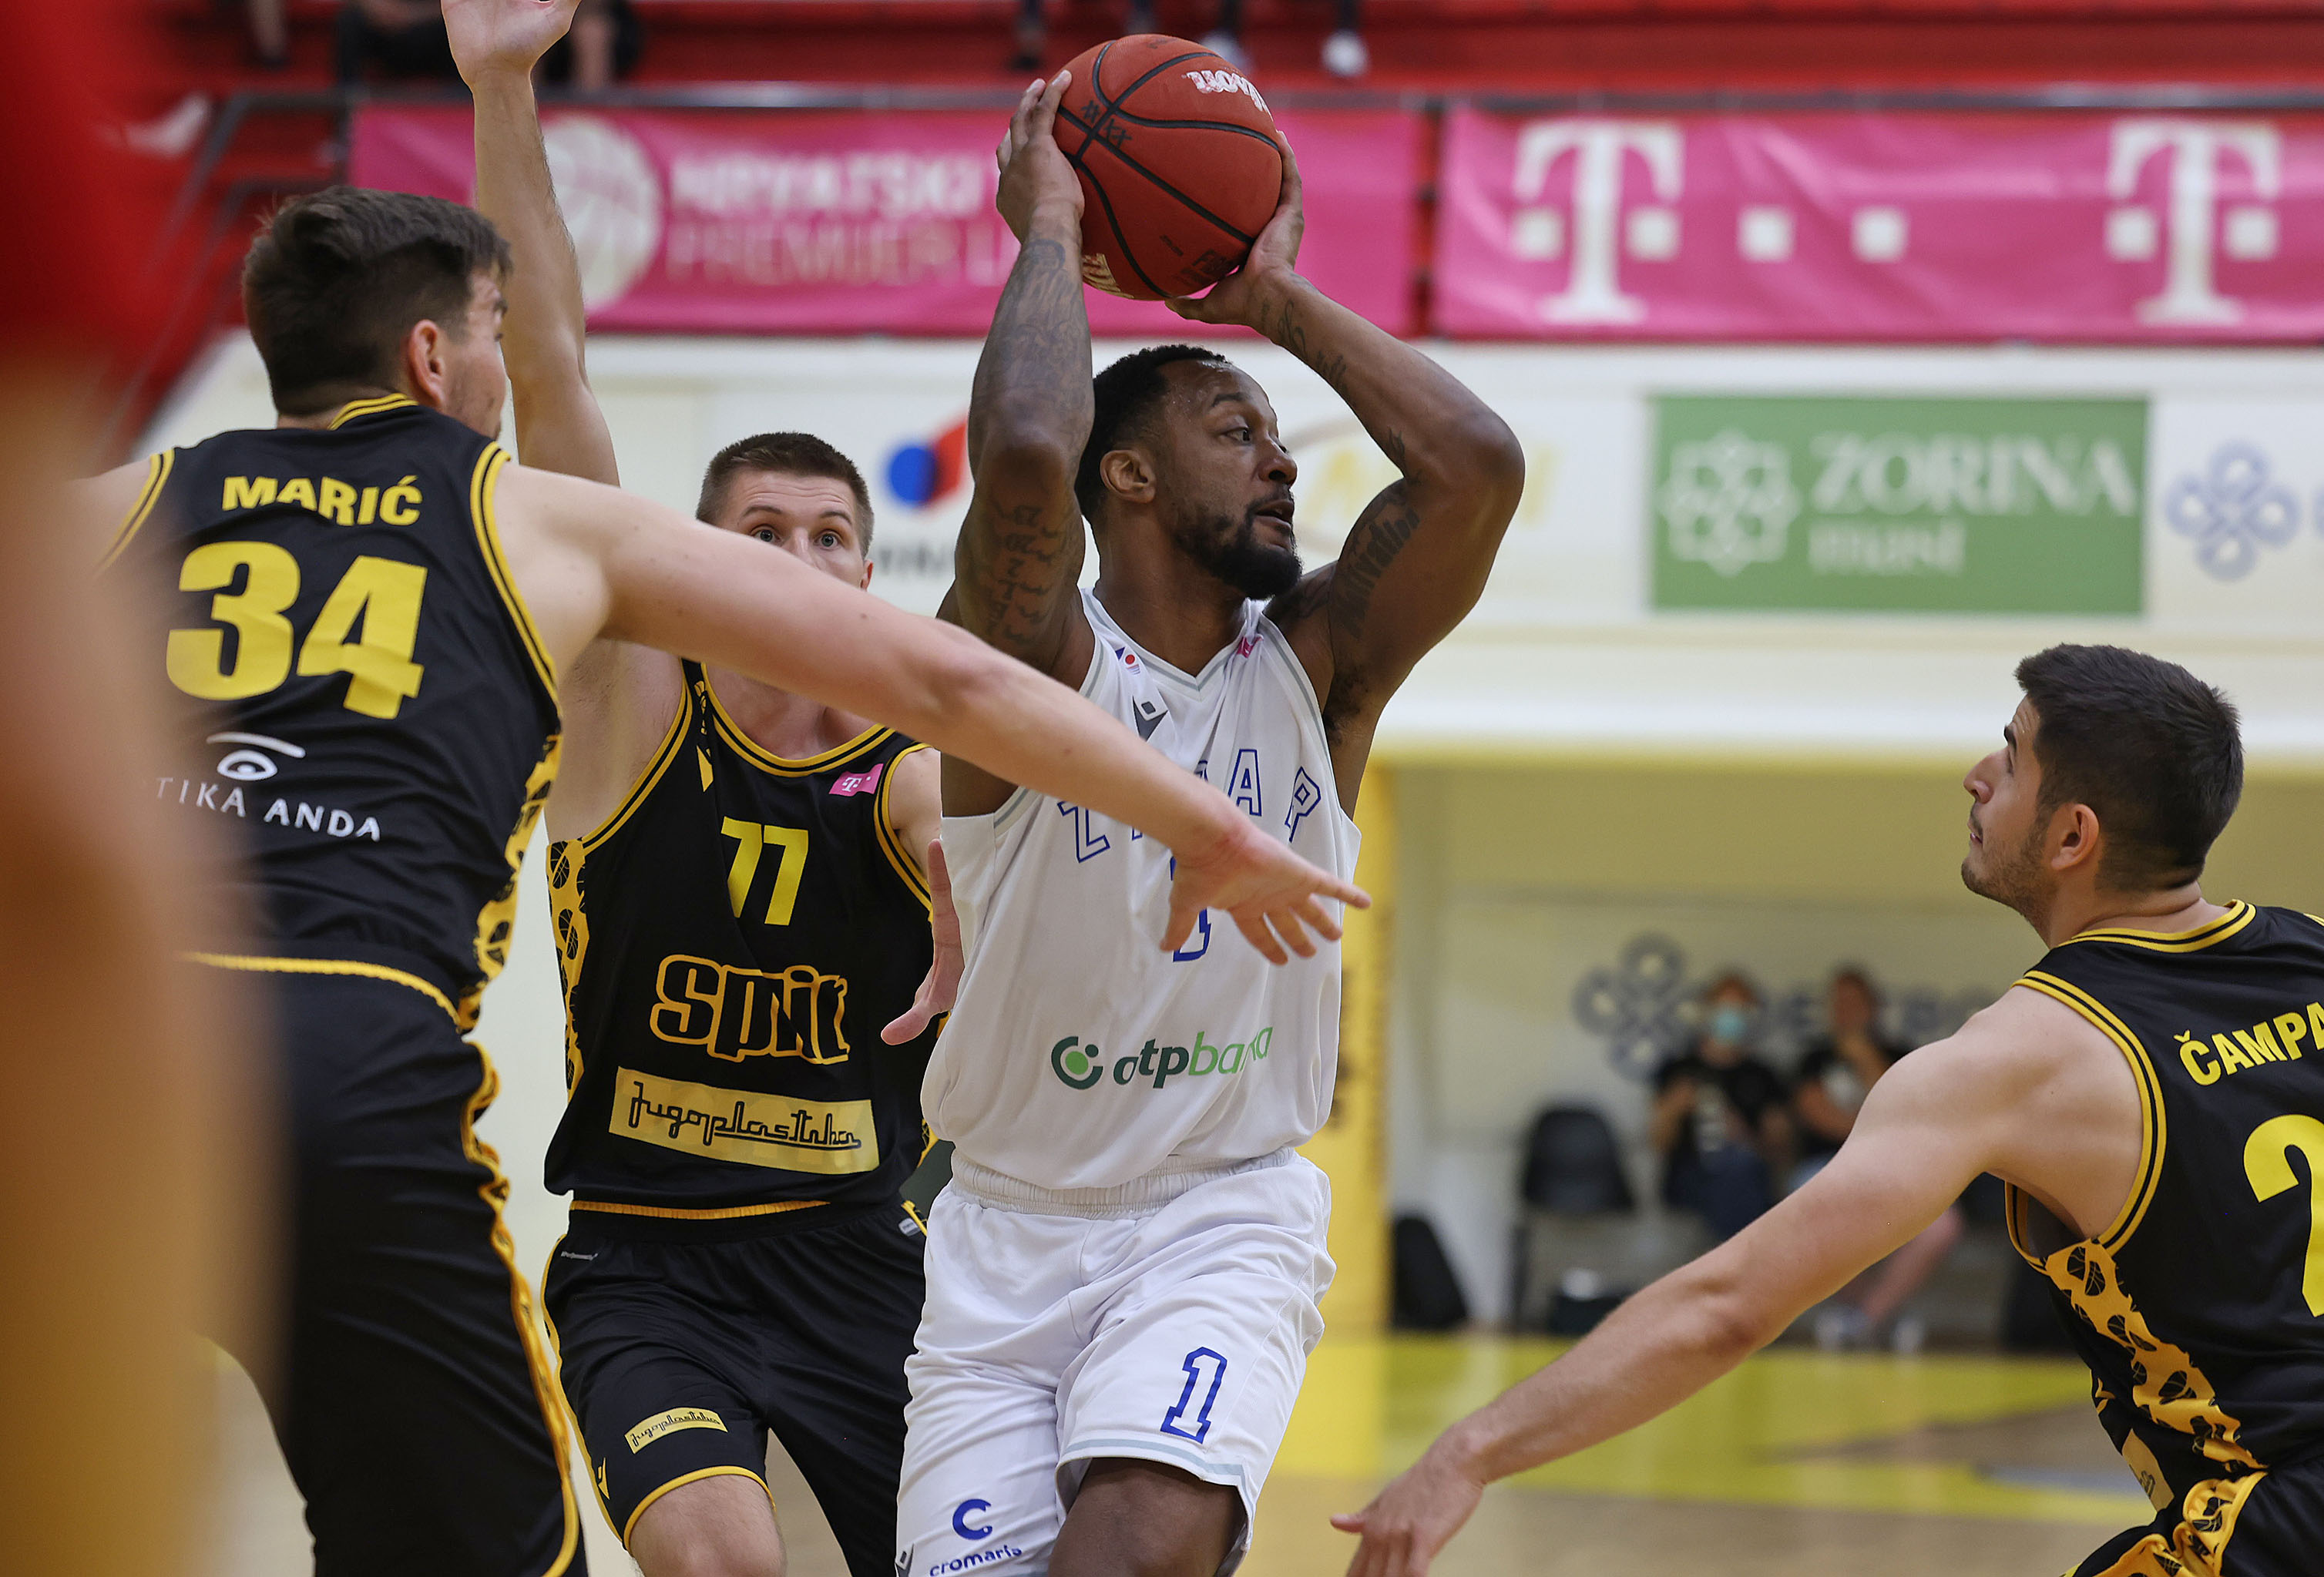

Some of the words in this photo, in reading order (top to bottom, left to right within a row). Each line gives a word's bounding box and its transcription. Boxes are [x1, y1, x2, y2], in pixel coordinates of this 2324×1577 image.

[222, 475, 424, 525] MARIĆ
[1809, 433, 2136, 515] ZORINA
[166, 541, 428, 720] 34
[156, 777, 247, 817] TIKA
[264, 797, 381, 841] ANDA
[720, 817, 809, 926] 77
[1160, 1346, 1228, 1444] 1
